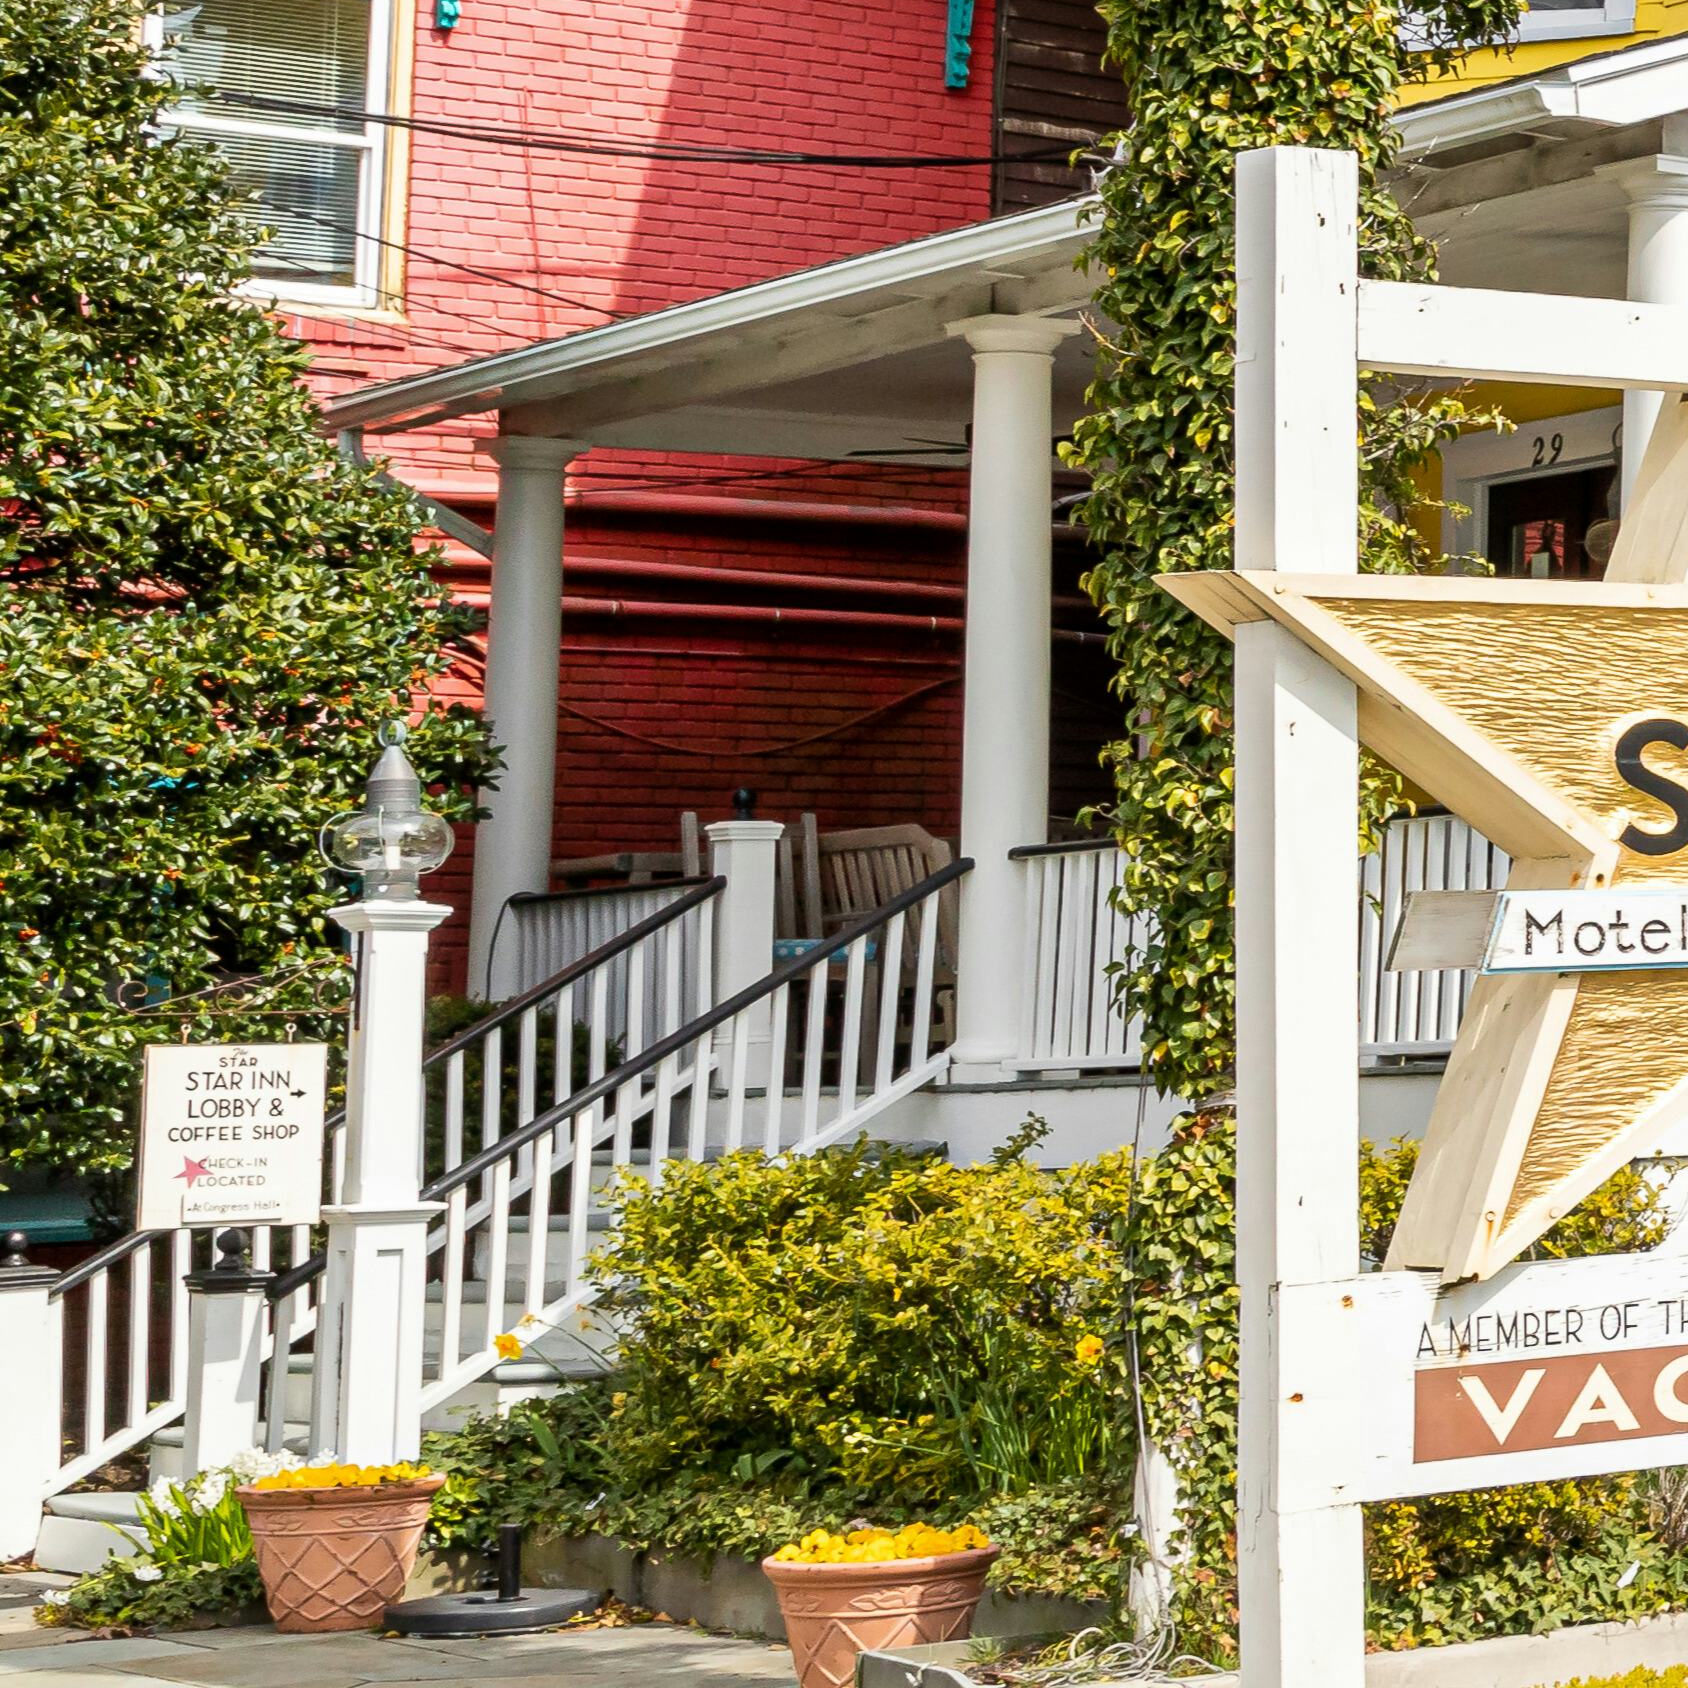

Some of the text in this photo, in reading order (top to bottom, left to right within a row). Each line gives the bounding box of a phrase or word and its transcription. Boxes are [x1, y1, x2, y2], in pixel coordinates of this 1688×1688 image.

[1532, 433, 1564, 467] 29
[1524, 904, 1688, 956] Motel
[219, 1057, 258, 1068] STAR
[185, 1070, 290, 1091] STAR INN
[187, 1097, 284, 1118] LOBBY &
[168, 1124, 300, 1142] COFFEE SHOP
[198, 1157, 268, 1169] CHECK-IN
[197, 1175, 266, 1187] LOCATED
[203, 1201, 249, 1214] Congress
[1417, 1321, 1437, 1358] A
[1449, 1310, 1583, 1355] MEMBER
[1600, 1303, 1640, 1341] OF
